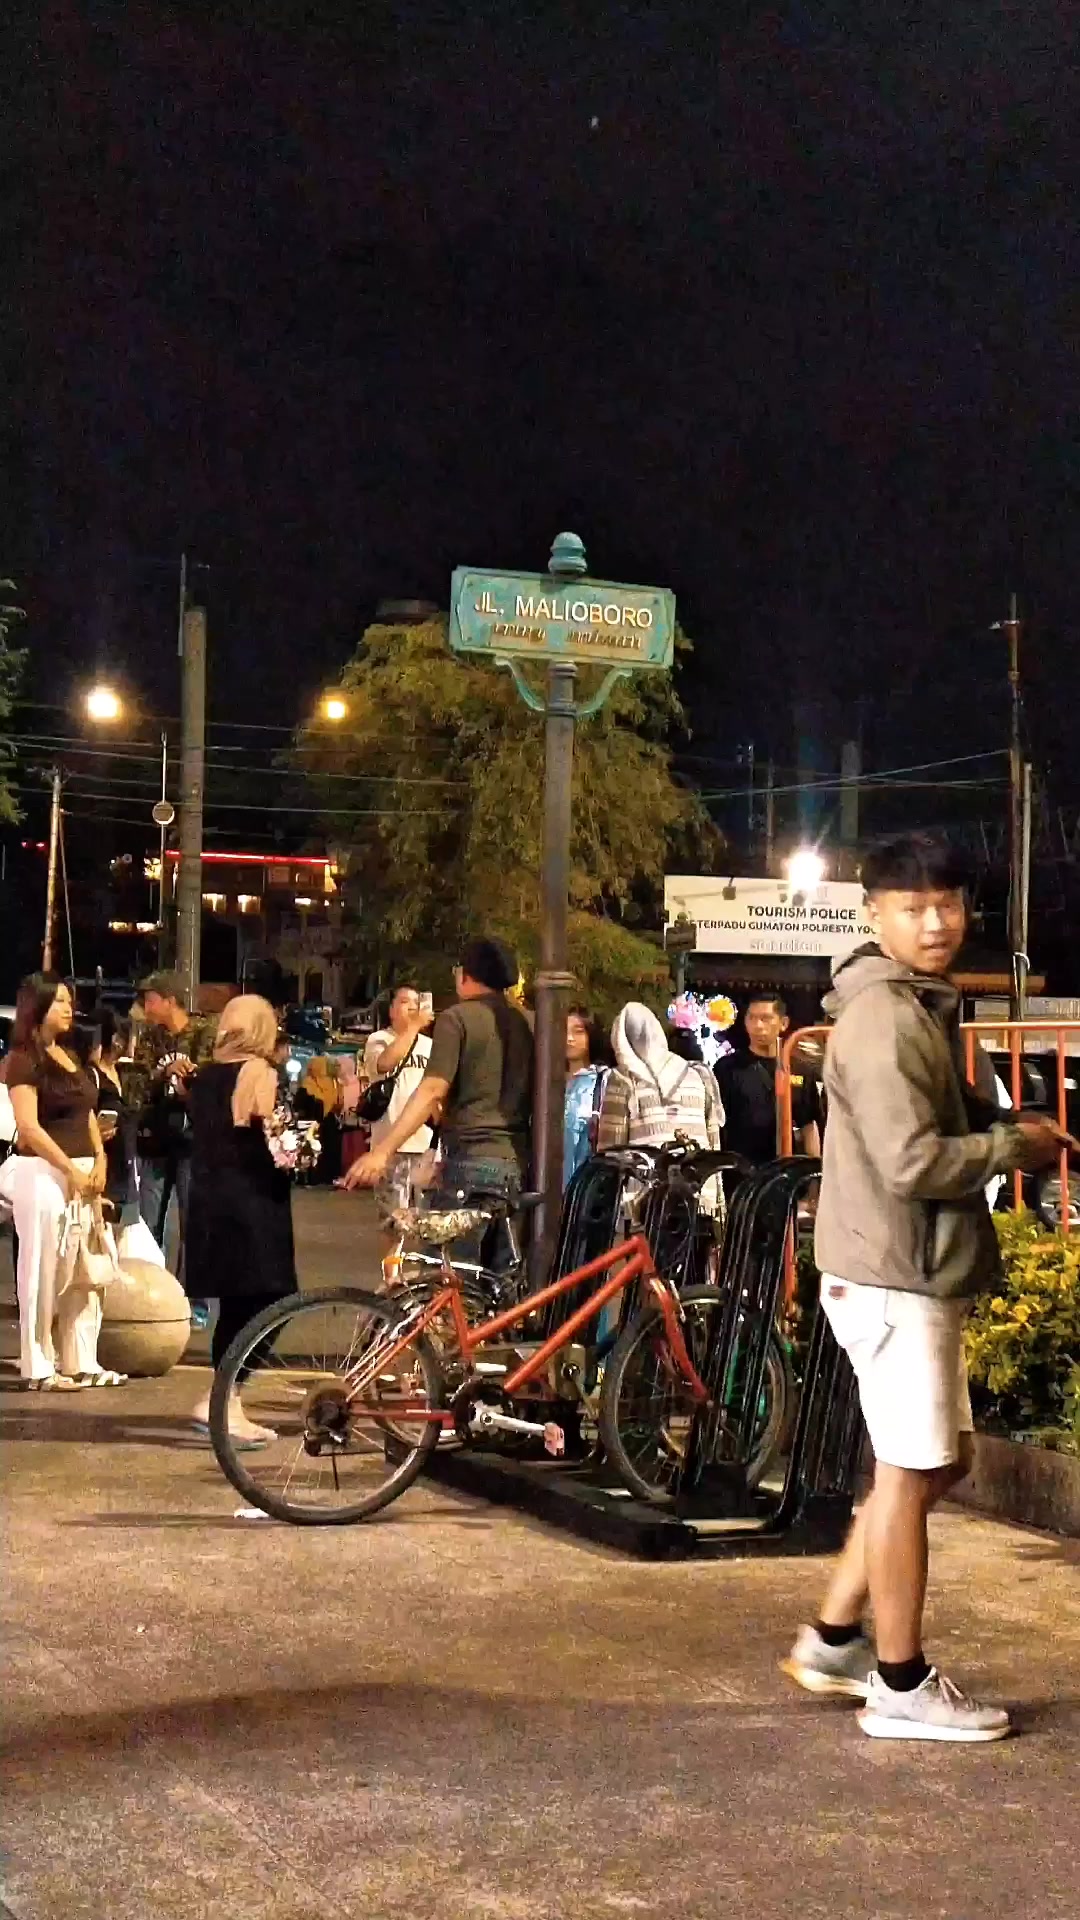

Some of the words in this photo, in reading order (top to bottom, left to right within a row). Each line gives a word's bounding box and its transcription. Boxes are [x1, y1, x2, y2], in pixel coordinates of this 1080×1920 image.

[474, 591, 504, 616] JL.
[515, 595, 653, 628] MALIOBORO
[747, 905, 806, 919] TOURISM
[810, 907, 857, 920] POLICE
[698, 919, 746, 930] TERPADU
[748, 921, 800, 932] GUMATON
[802, 923, 854, 934] POLRESTA
